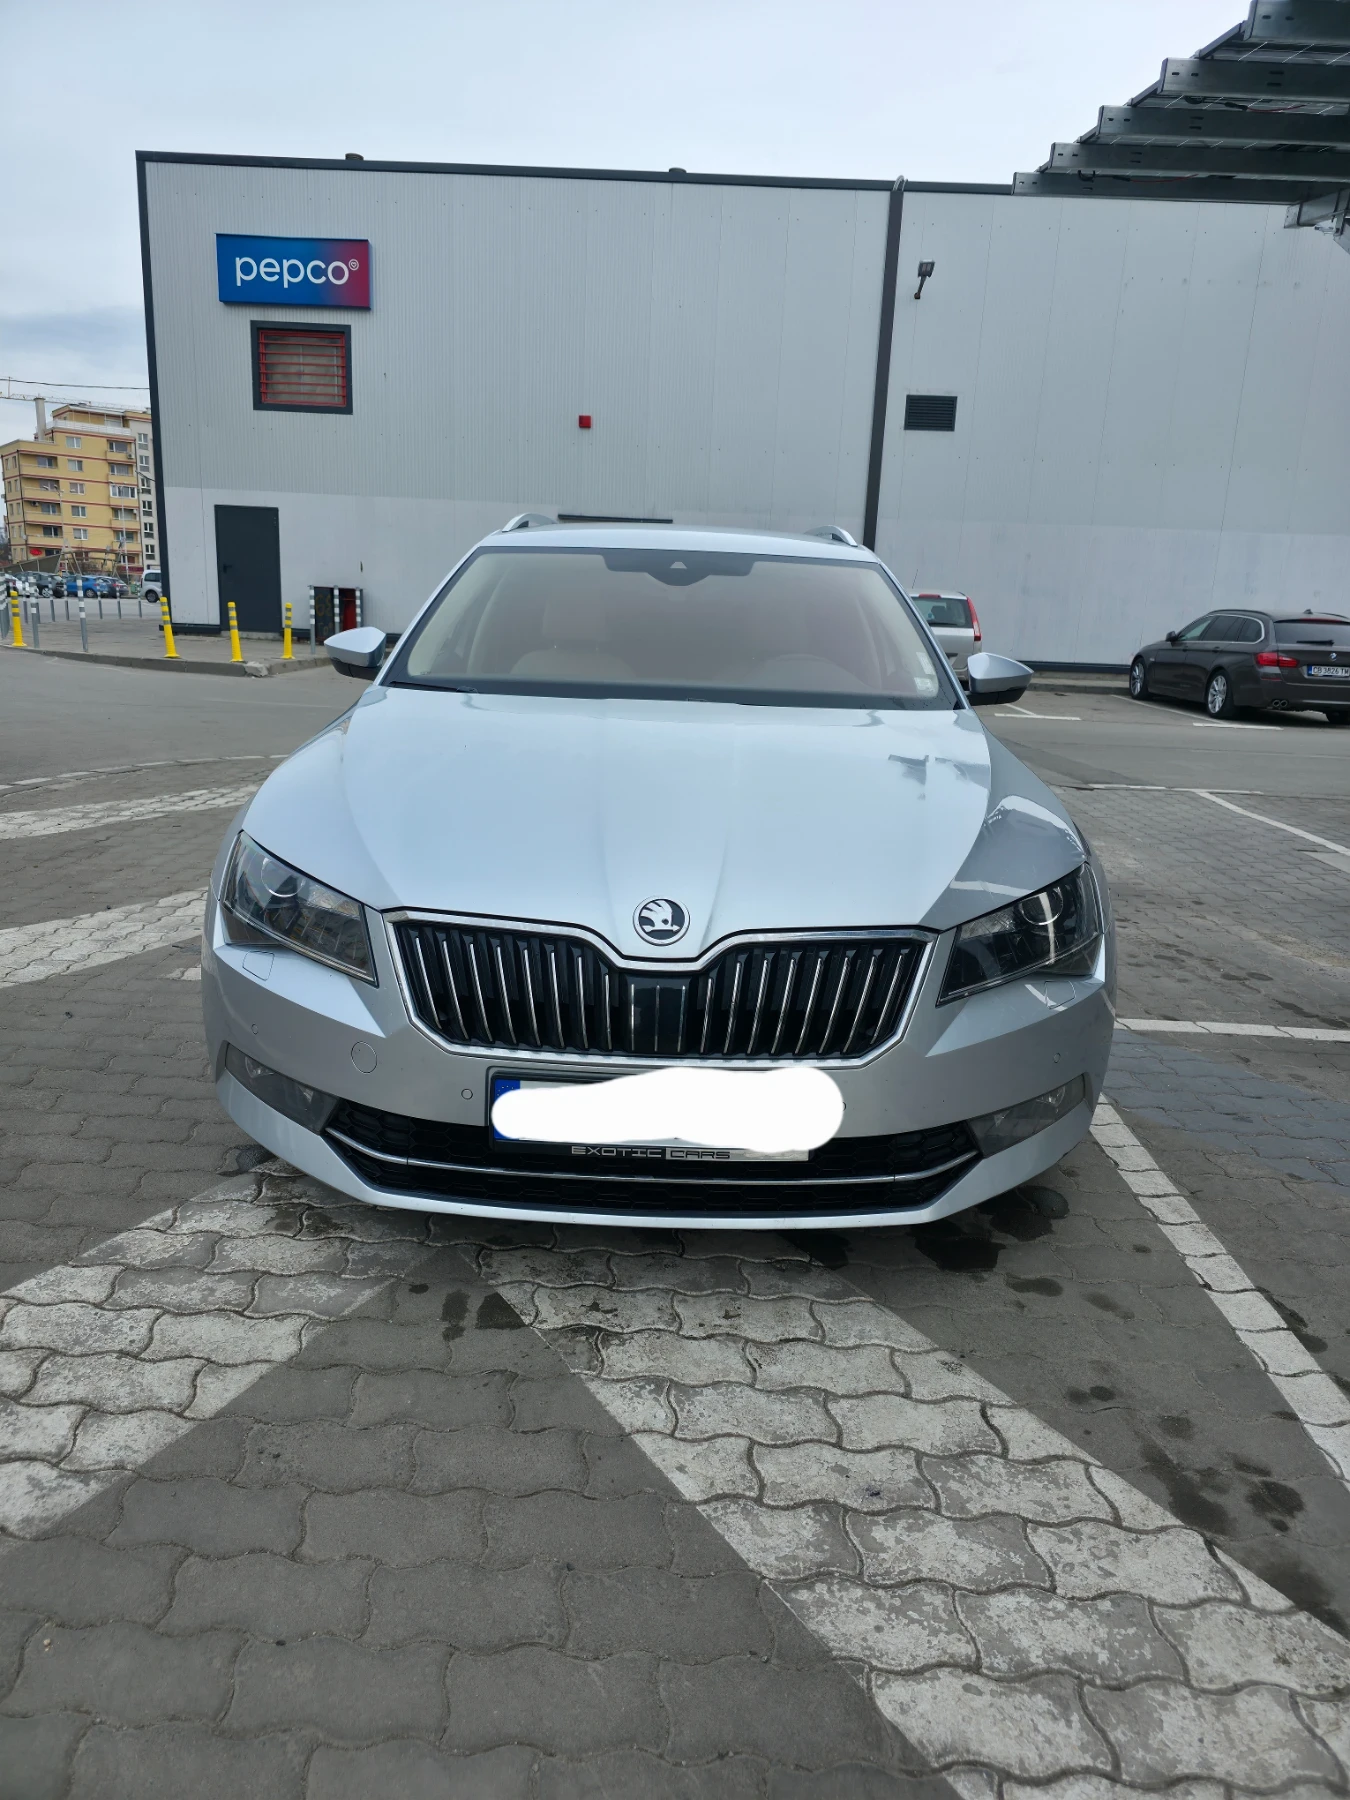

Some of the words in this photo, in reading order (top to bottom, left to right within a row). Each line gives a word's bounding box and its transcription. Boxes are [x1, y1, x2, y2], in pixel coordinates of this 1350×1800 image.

[235, 257, 349, 289] pepco
[571, 1145, 662, 1158] EXOTIC
[670, 1150, 731, 1160] CARS
